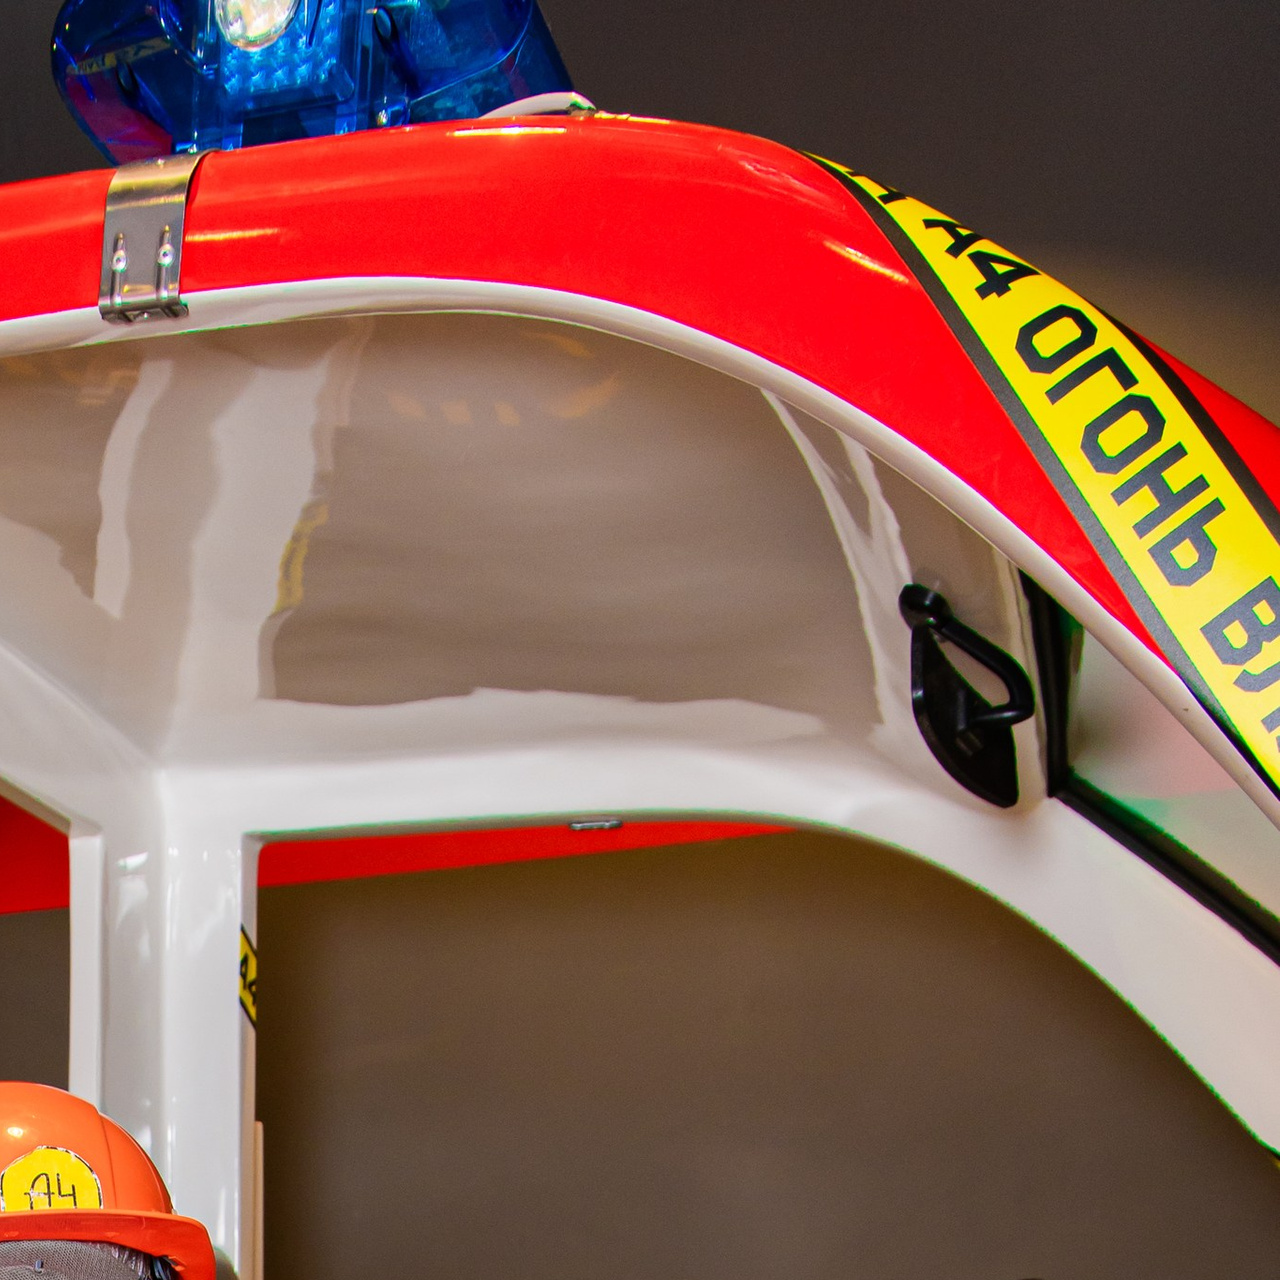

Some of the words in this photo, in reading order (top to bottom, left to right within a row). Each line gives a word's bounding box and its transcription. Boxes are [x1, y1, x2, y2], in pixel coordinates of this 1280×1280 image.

[922, 218, 1043, 301] А4
[1015, 303, 1226, 587] ОГОНЬ
[23, 1172, 77, 1210] A4
